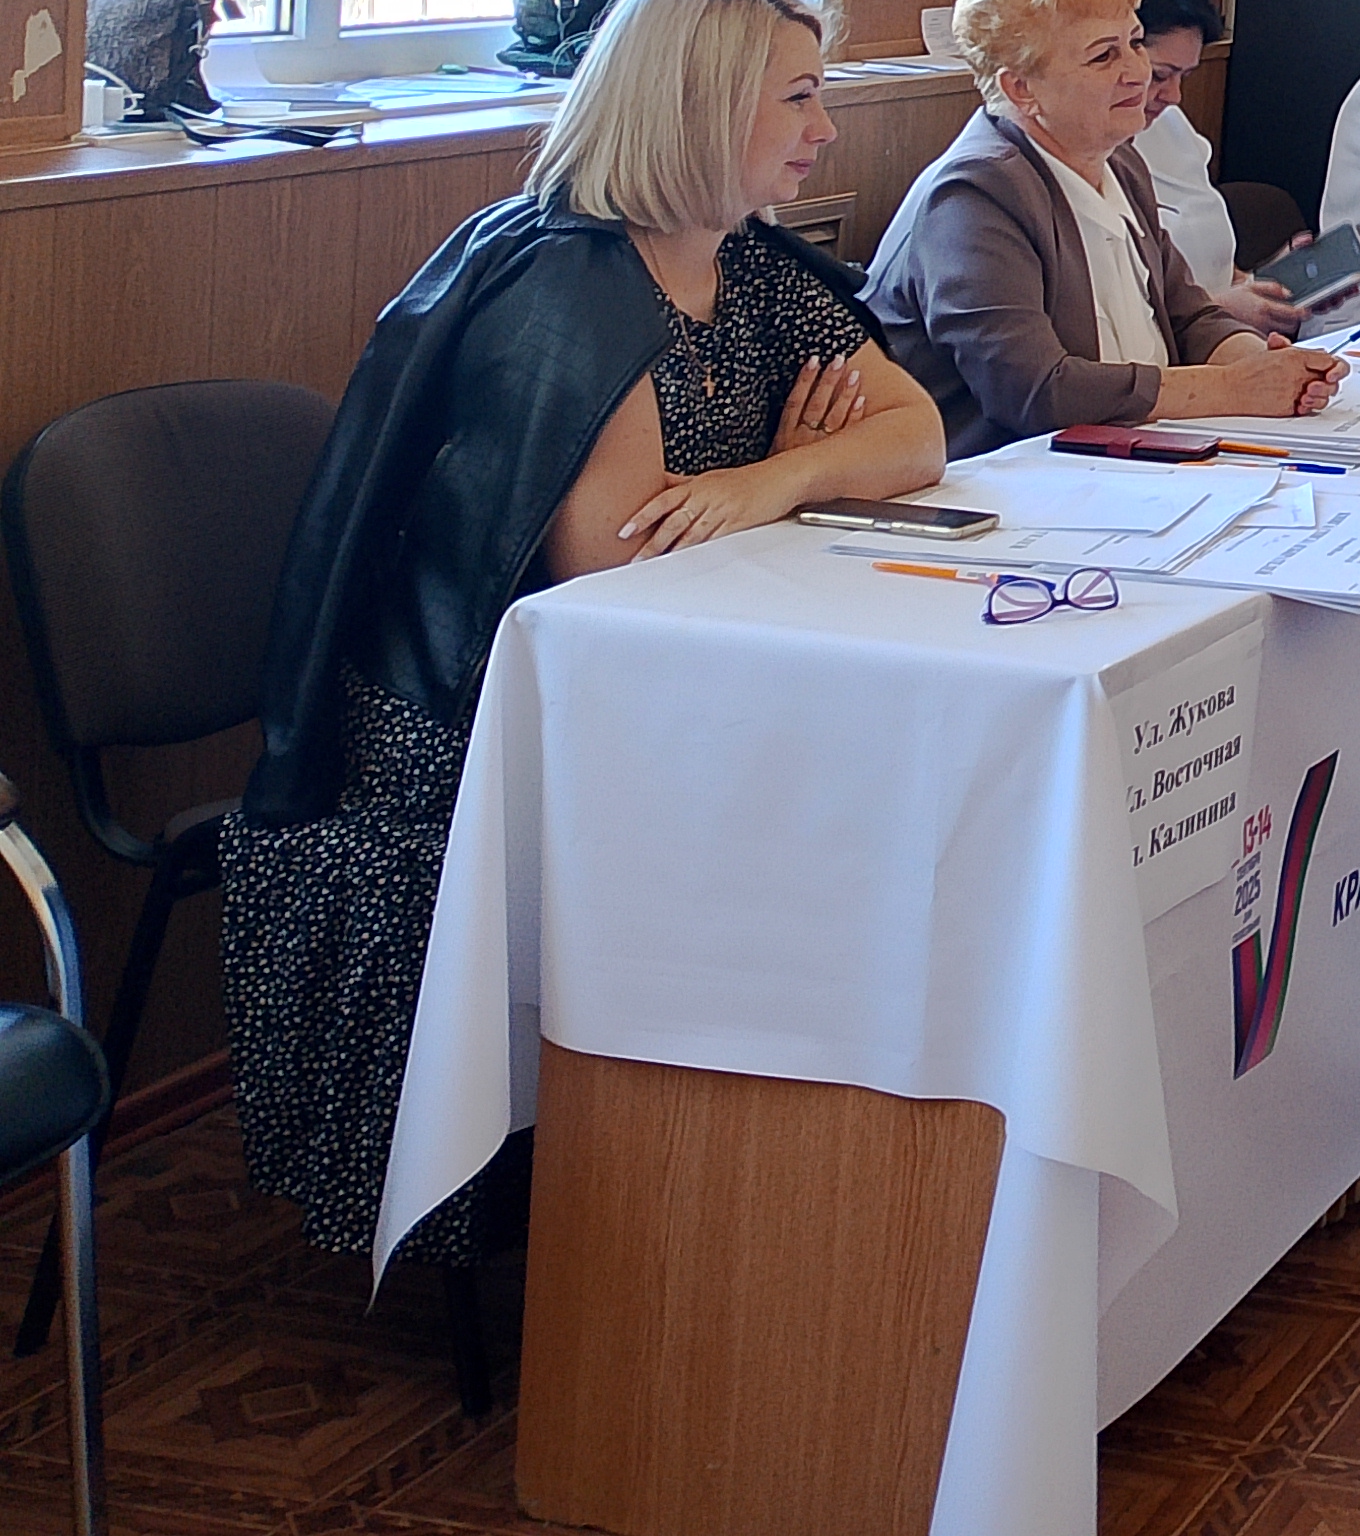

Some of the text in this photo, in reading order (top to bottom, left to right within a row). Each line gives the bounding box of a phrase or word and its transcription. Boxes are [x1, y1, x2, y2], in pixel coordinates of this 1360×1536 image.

[1134, 685, 1235, 755] Ул. Жукова
[1152, 735, 1242, 802] Восточная
[1149, 792, 1236, 858] Калинина
[1234, 870, 1262, 916] 2025
